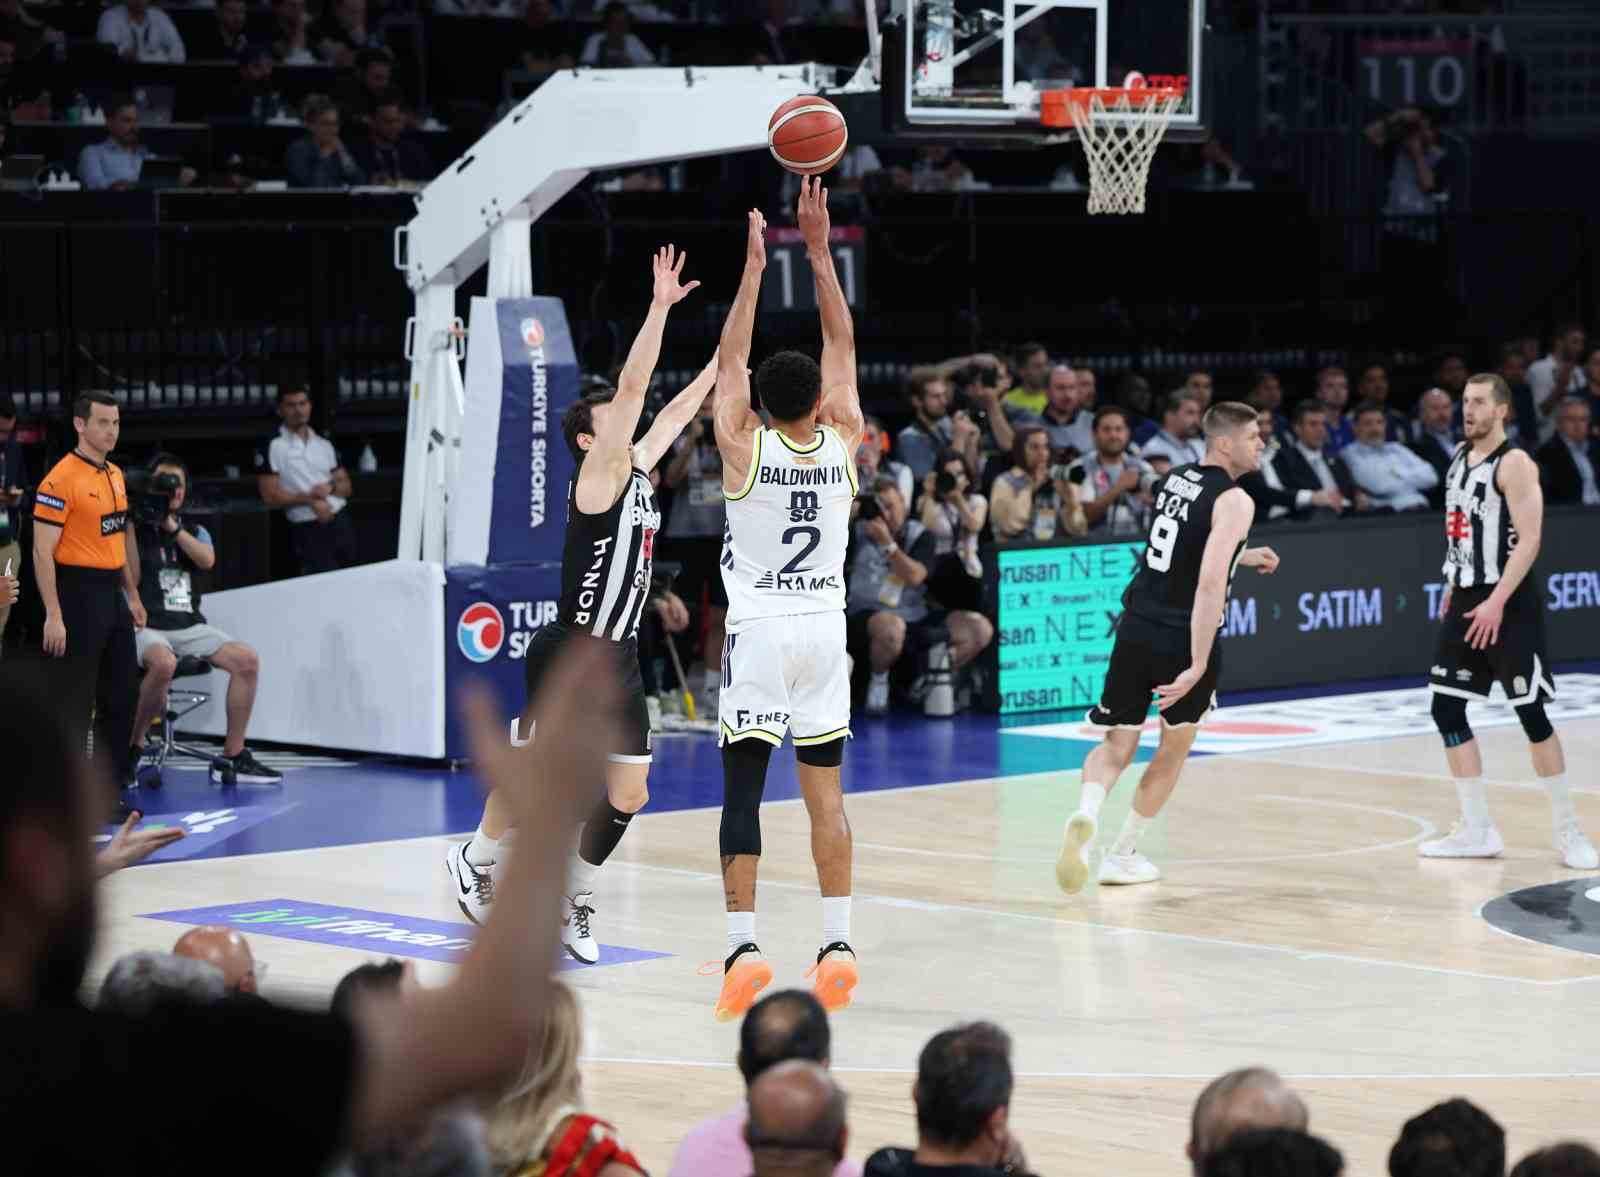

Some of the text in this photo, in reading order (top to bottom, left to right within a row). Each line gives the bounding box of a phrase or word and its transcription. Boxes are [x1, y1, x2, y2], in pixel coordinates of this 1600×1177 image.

[1360, 56, 1464, 104] 110
[773, 248, 856, 308] 11
[759, 465, 844, 486] BALDWIN IV
[778, 525, 821, 574] 2
[1146, 514, 1179, 572] 9
[1297, 587, 1382, 631] SATIM
